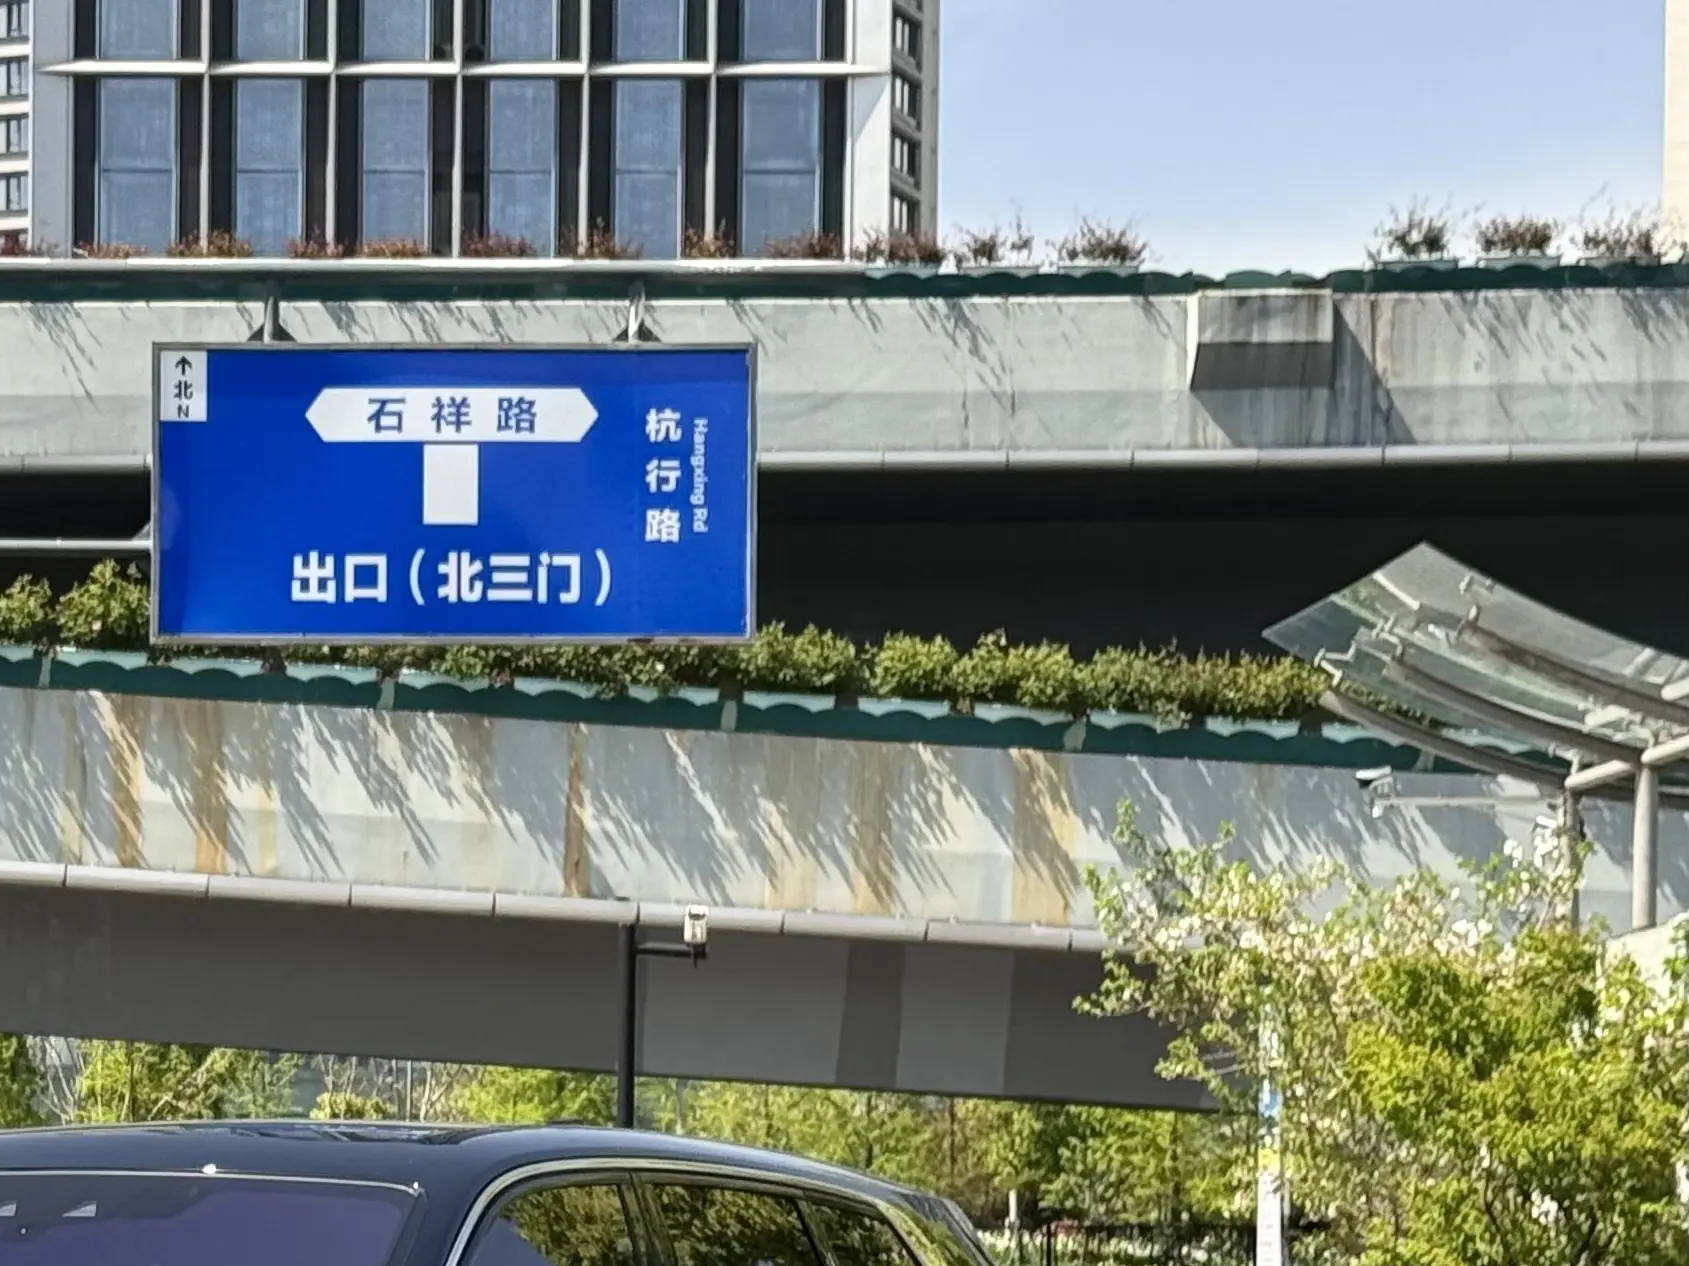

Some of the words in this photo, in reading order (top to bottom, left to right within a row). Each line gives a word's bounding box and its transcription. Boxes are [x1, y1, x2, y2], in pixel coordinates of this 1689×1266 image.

[173, 379, 194, 400] 北
[177, 404, 190, 419] N
[367, 396, 537, 433] 石祥路
[645, 408, 683, 543] 杭行路
[693, 508, 709, 532] Rd
